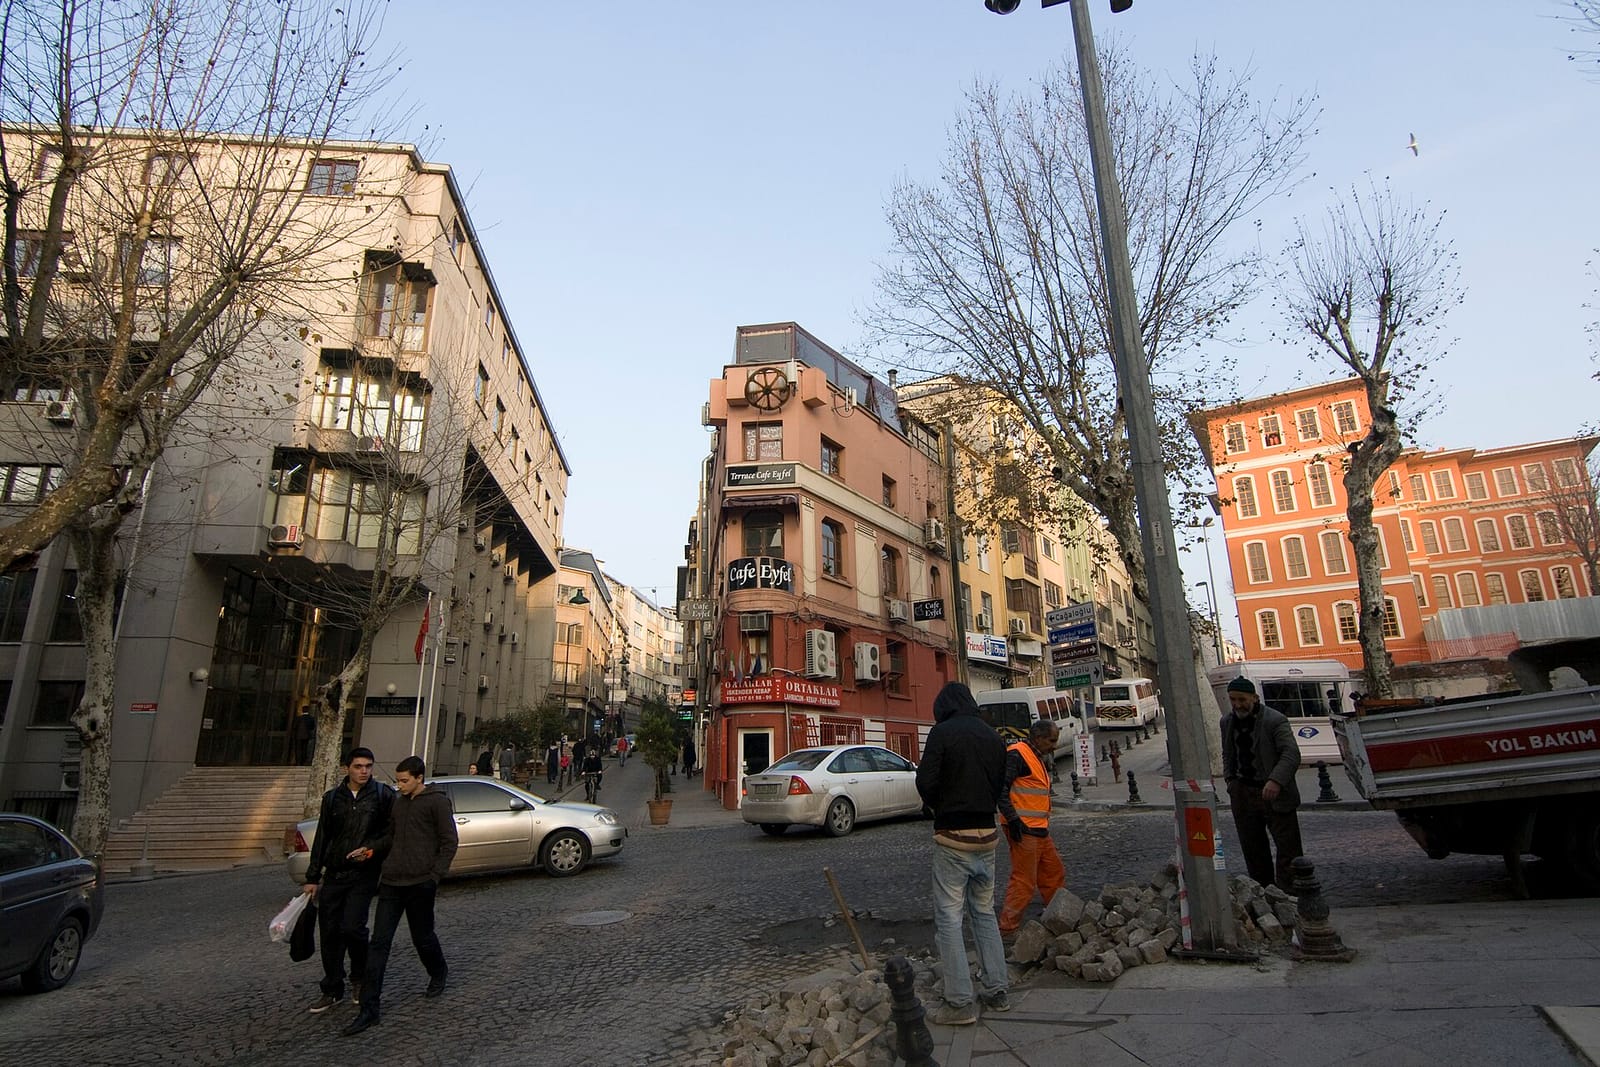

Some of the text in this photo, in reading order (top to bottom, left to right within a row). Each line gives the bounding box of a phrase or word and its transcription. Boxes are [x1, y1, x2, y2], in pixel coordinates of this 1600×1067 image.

[730, 469, 793, 482] Terrace Cafe Eyfel
[730, 562, 792, 586] Cafe Eyfel
[692, 602, 709, 610] Cafe
[925, 601, 940, 609] Cafe
[692, 610, 710, 619] Eyfel
[925, 608, 942, 618] Eyfel
[1055, 607, 1091, 621] Cağaloğlu
[966, 636, 985, 652] Friends
[1053, 647, 1090, 660] Sultanahmet
[785, 681, 838, 697] ORTAKLAR
[1486, 729, 1597, 753] YOL BAKIM
